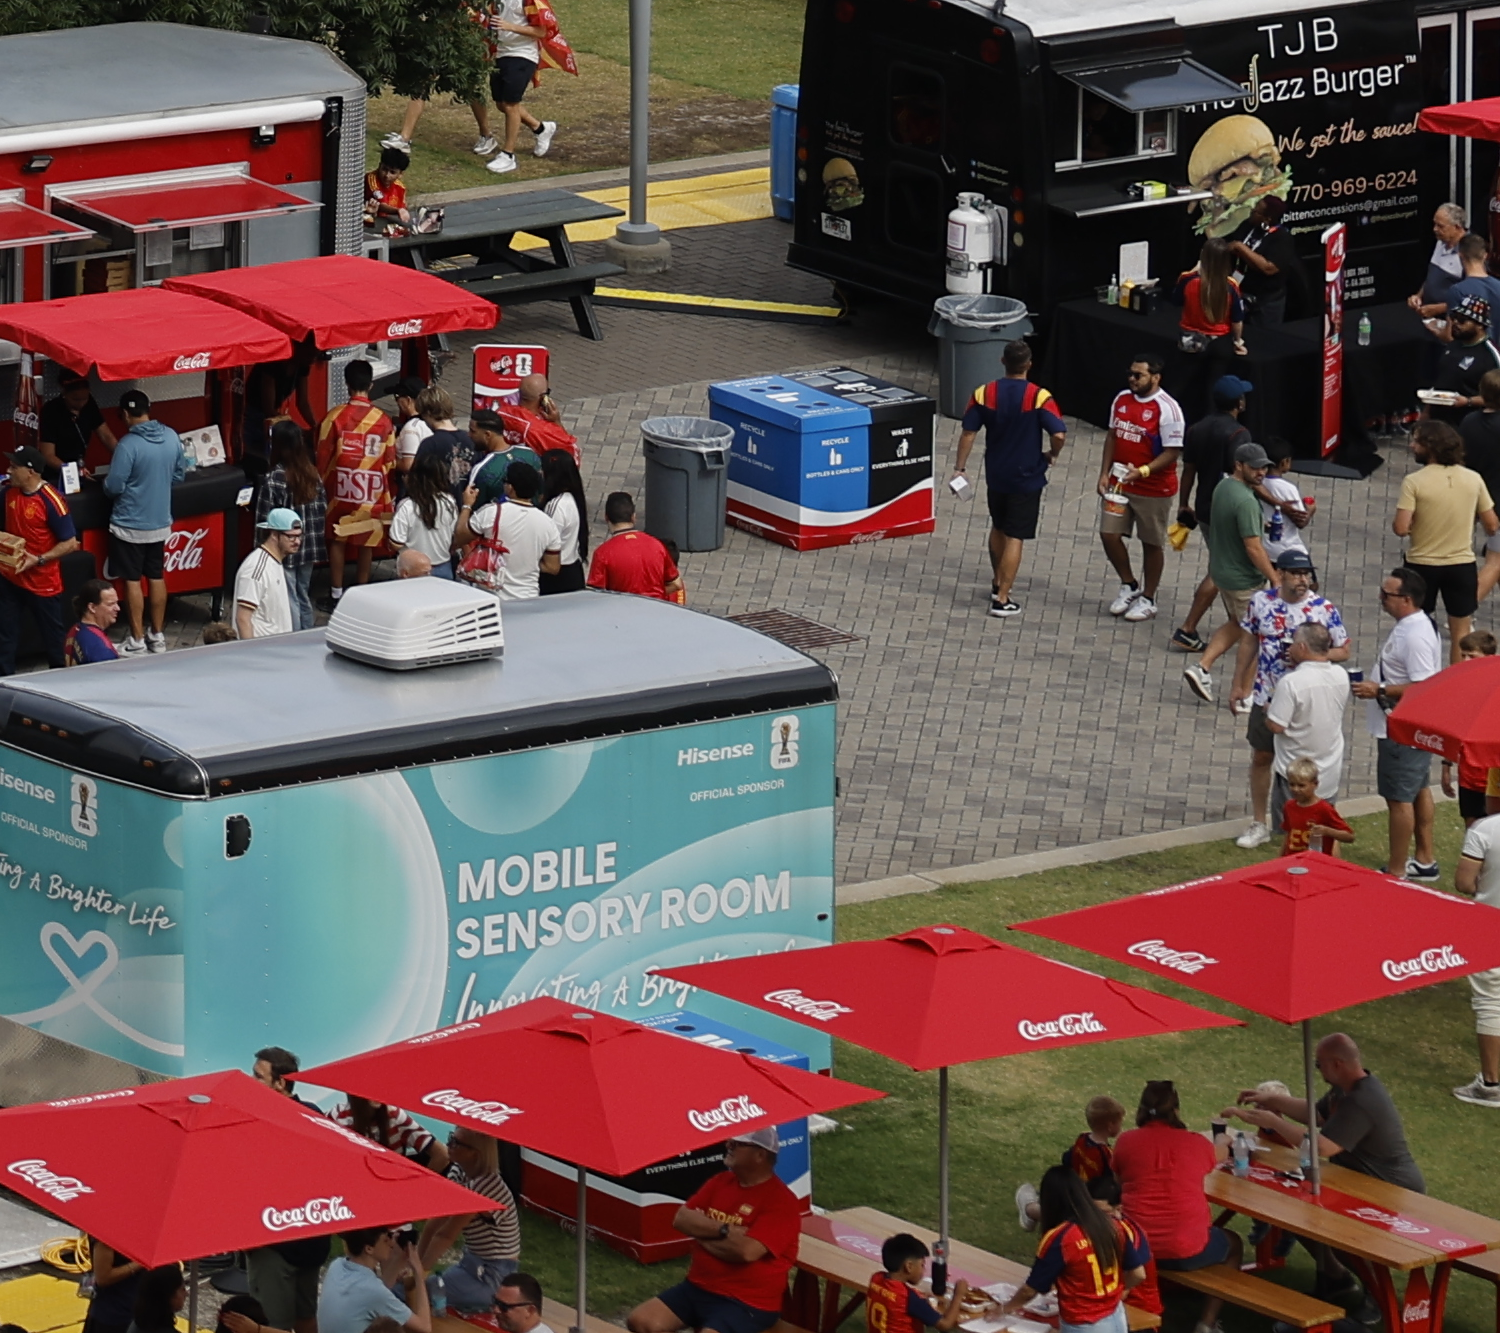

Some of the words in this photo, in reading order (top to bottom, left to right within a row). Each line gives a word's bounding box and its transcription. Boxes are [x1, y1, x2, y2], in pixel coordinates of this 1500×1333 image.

[1257, 17, 1339, 59] TJB
[1242, 53, 1306, 112] Jazz
[1278, 126, 1306, 154] We
[1307, 120, 1337, 159] got
[1340, 117, 1367, 144] the
[1371, 112, 1421, 139] sauce!
[1291, 169, 1418, 204] 770-969-6224
[173, 351, 211, 371] Coca-Cola
[821, 436, 850, 447] RECYCLE
[891, 427, 913, 437] WASTE
[333, 466, 384, 505] ESP
[677, 741, 754, 767] Hisense
[689, 787, 735, 803] OFFICIAL
[737, 778, 785, 797] SPONSOR
[0, 811, 40, 836] OFFICIAL
[41, 824, 88, 851] SPONSOR
[457, 841, 618, 904] MOBILE
[29, 872, 41, 892] A
[46, 874, 126, 915] Brighter
[128, 901, 177, 936] Life
[456, 892, 652, 960] SENSORY
[660, 870, 791, 930] ROOM
[1127, 939, 1219, 974] Coca-Cola
[1381, 944, 1468, 982] Coca-Cola
[764, 987, 853, 1022] Coca-Cola
[1017, 1010, 1107, 1041] Coca-Cola
[421, 1088, 524, 1127] Coca-Cola
[687, 1095, 770, 1134] Coca-Cola
[7, 1158, 94, 1203] Coca-Cola
[260, 1195, 356, 1232] Coca-Cola
